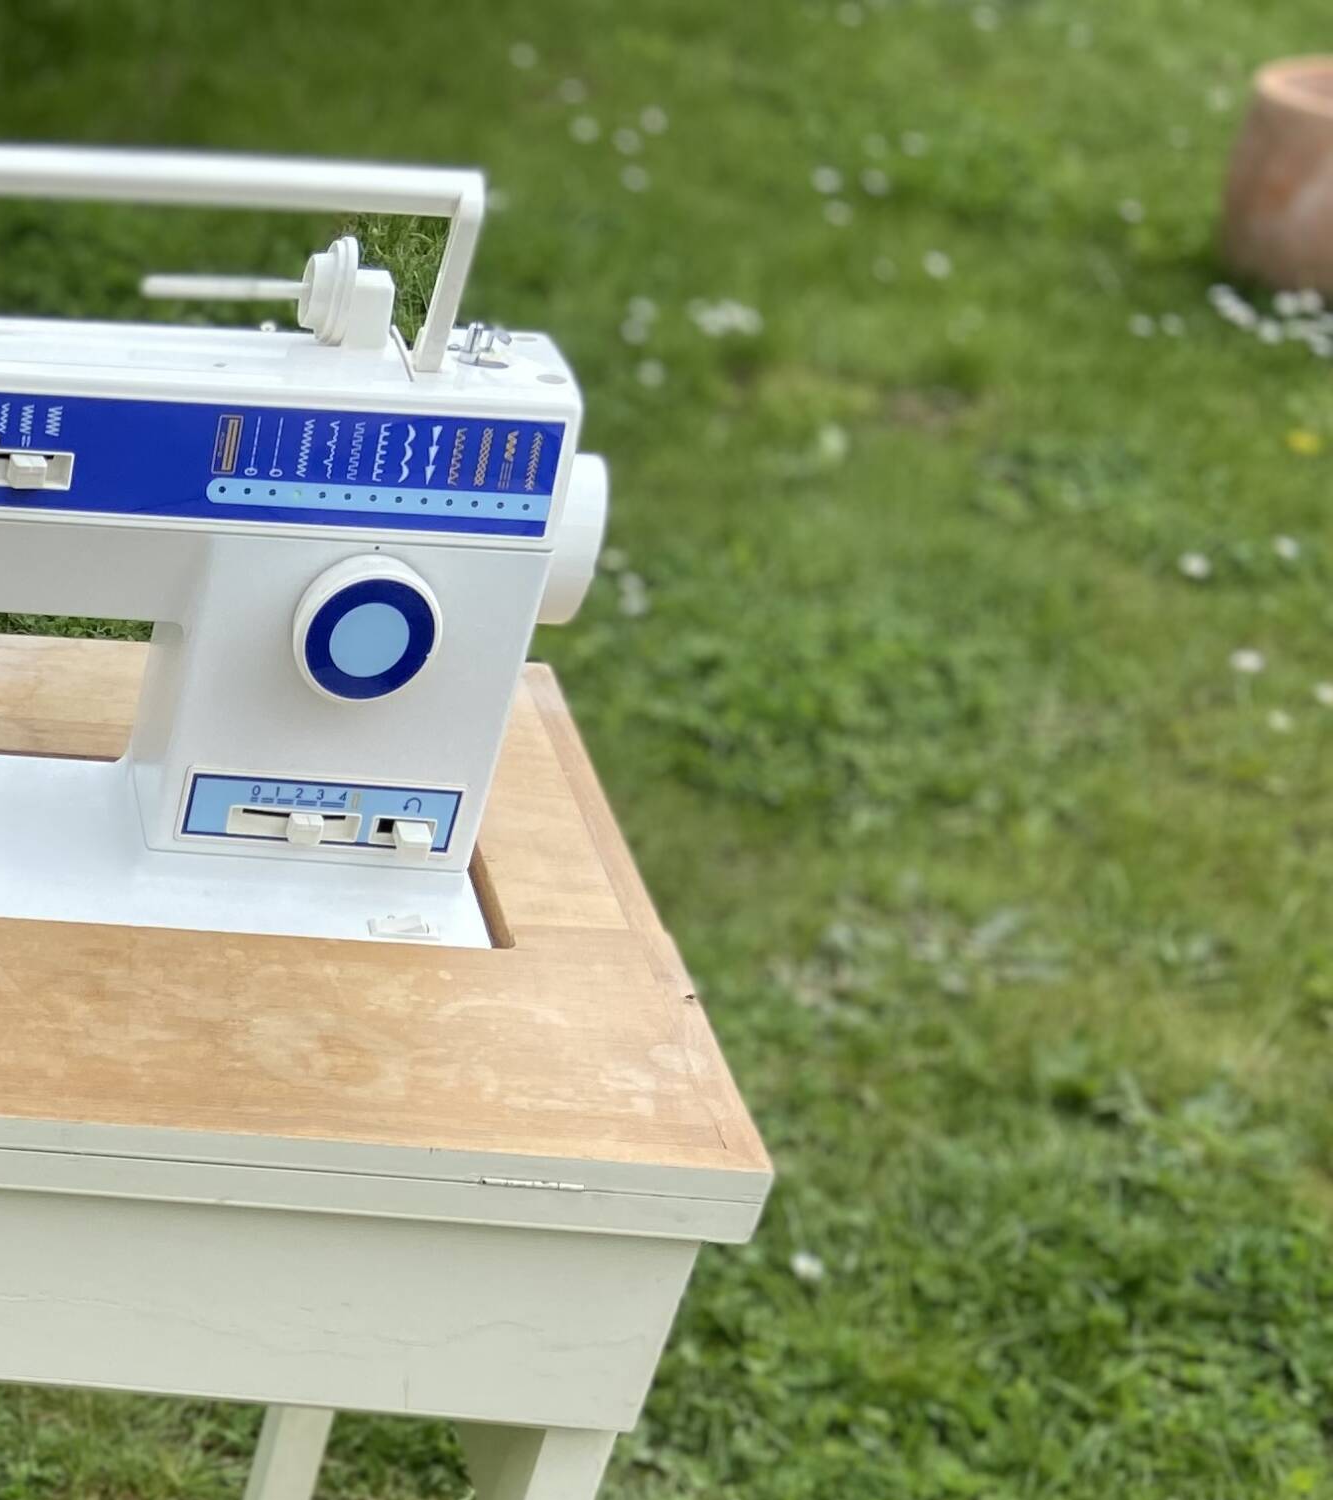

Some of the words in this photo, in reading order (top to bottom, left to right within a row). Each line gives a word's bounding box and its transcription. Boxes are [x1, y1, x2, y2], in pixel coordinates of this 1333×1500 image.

[252, 785, 261, 796] 0
[295, 787, 303, 799] 2
[316, 788, 325, 800] 3
[339, 791, 348, 801] 4
